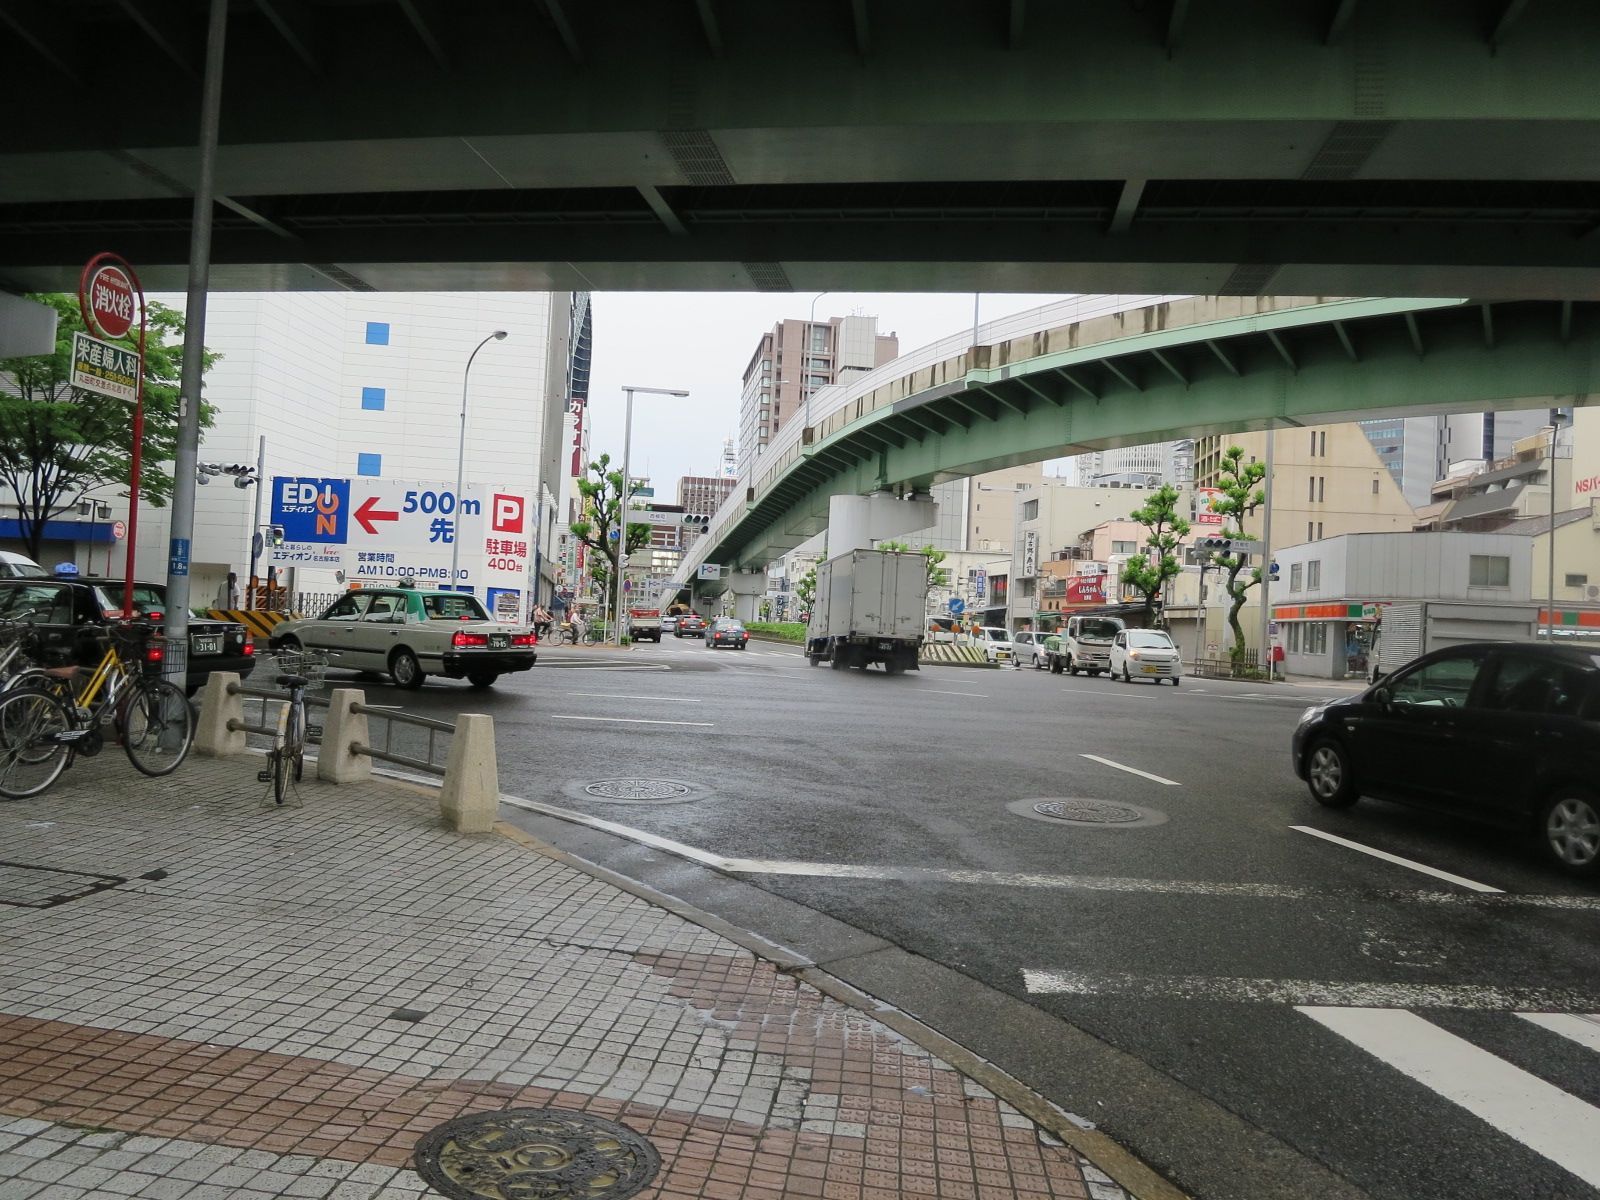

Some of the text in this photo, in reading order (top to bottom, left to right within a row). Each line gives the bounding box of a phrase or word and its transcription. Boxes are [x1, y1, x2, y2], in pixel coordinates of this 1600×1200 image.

[95, 283, 132, 320] 消火栓
[77, 338, 137, 378] 栄産婦人科
[281, 505, 315, 513] エディオン
[282, 482, 339, 535] EDION
[402, 490, 480, 515] 500m
[496, 498, 520, 527] P
[429, 517, 454, 543] 先
[273, 551, 312, 561] エディオン
[357, 552, 395, 563] 営業時間
[485, 538, 527, 557] 駐車場
[487, 557, 522, 572] 400台
